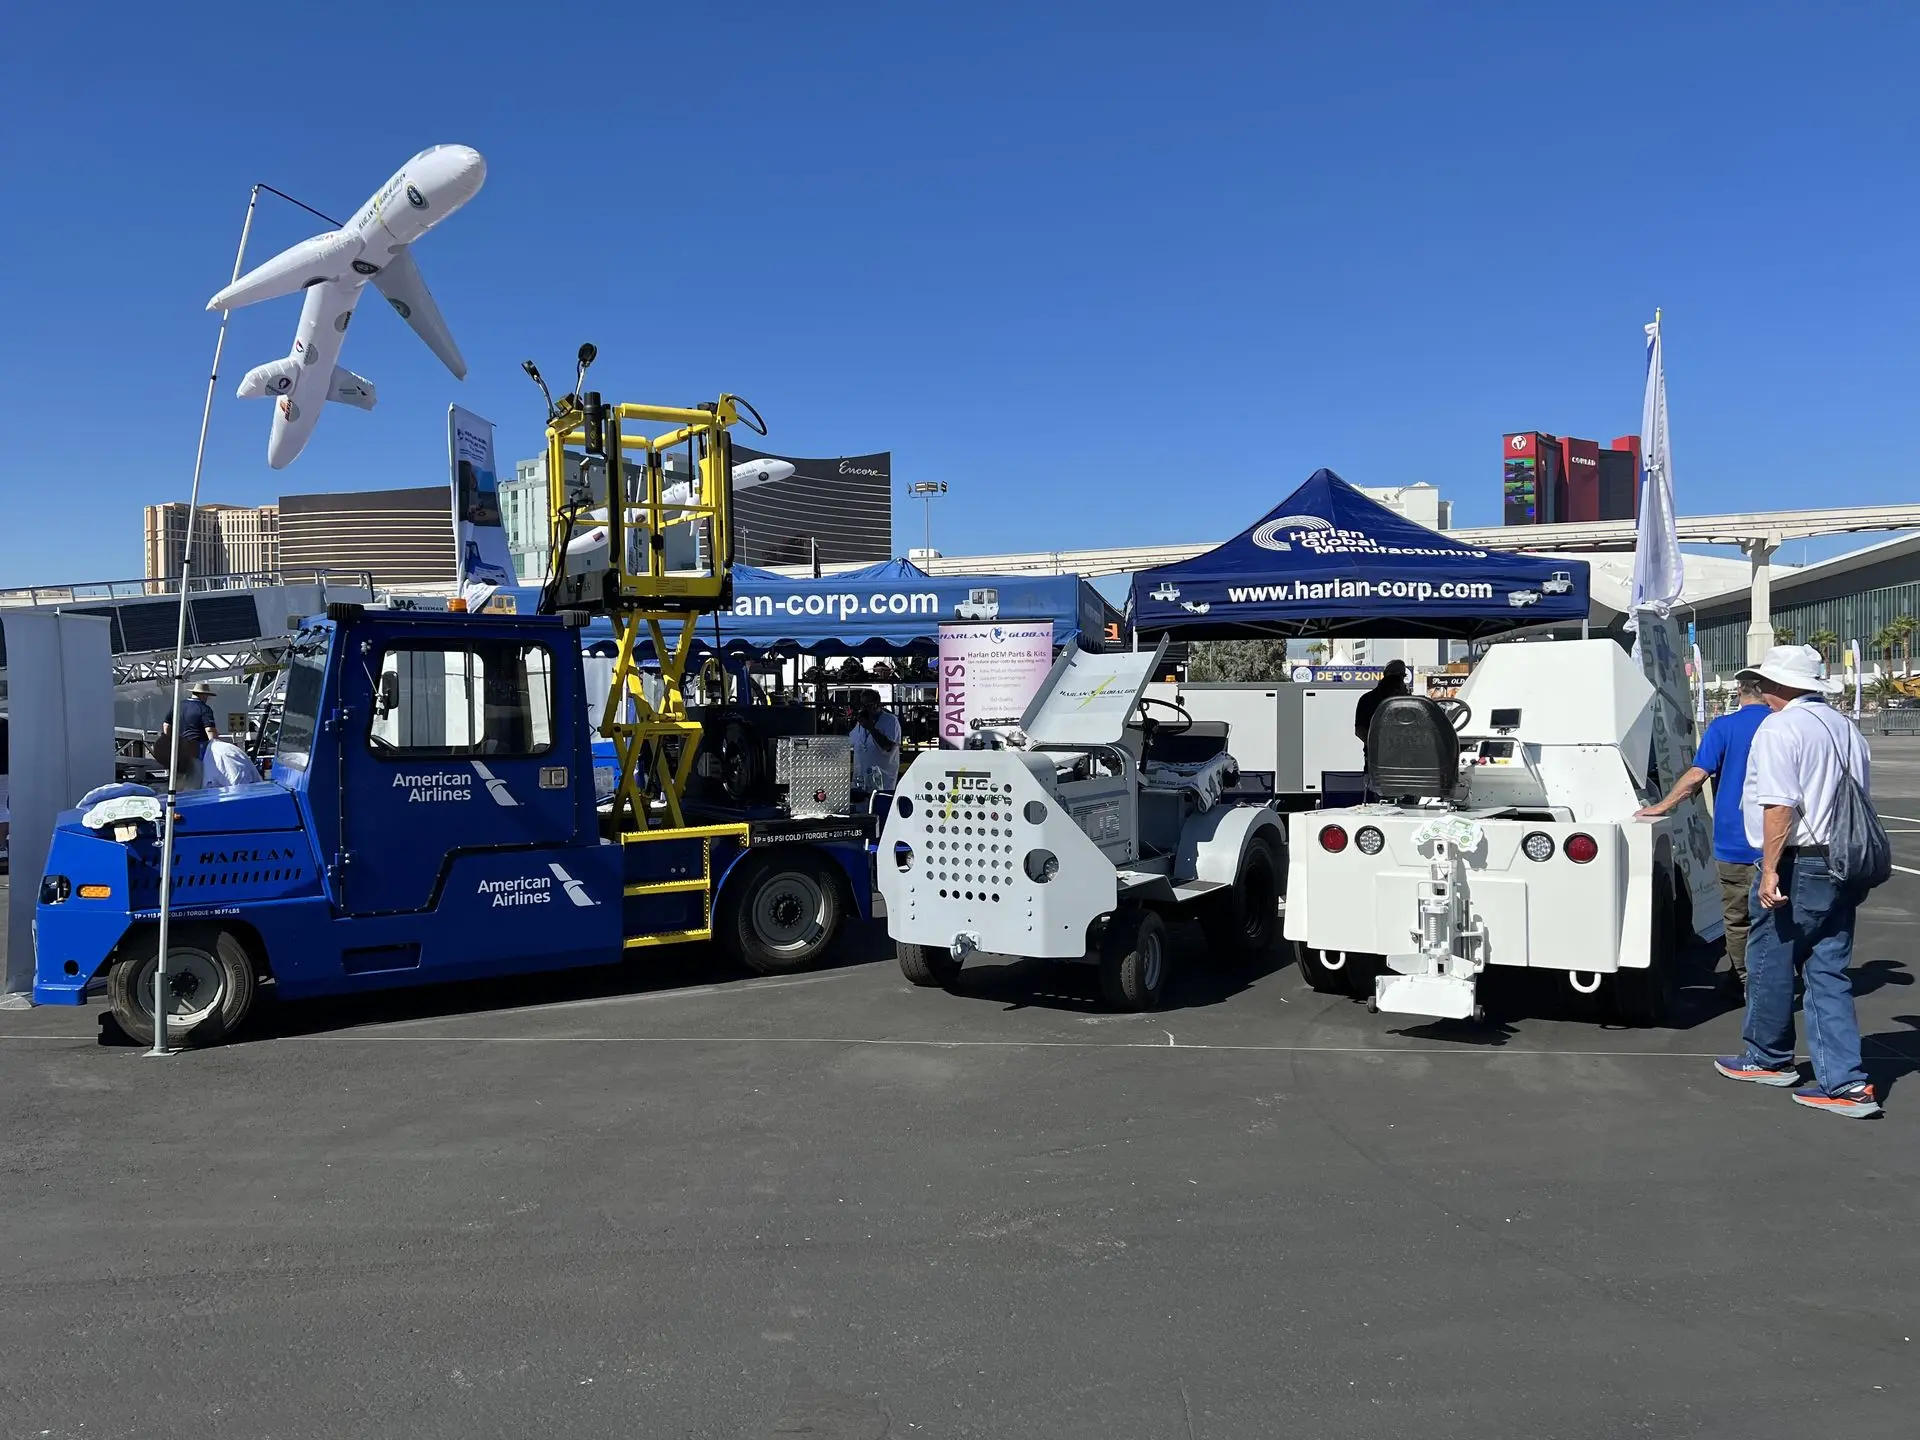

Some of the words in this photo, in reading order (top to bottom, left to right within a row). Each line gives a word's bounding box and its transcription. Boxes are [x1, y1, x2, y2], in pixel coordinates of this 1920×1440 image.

[838, 460, 889, 477] Encore
[1289, 528, 1364, 541] Harlan
[1302, 538, 1377, 548] Global
[1315, 545, 1488, 558] Manufacturing
[1227, 578, 1493, 602] www.harlan-corp.com
[729, 593, 938, 621] an-corp.com
[940, 632, 989, 640] HARLAN
[943, 656, 965, 737] PARTS!
[392, 771, 472, 787] American
[408, 787, 472, 802] Airlines
[914, 793, 946, 801] HALA
[957, 793, 985, 801] GLBA
[785, 833, 801, 841] COLD
[805, 831, 828, 840] TORQUE
[843, 829, 862, 837] FT-LBS
[200, 847, 296, 865] HARLAN
[477, 876, 551, 894] American
[492, 890, 551, 907] Airlines
[186, 909, 209, 917] TORQUE
